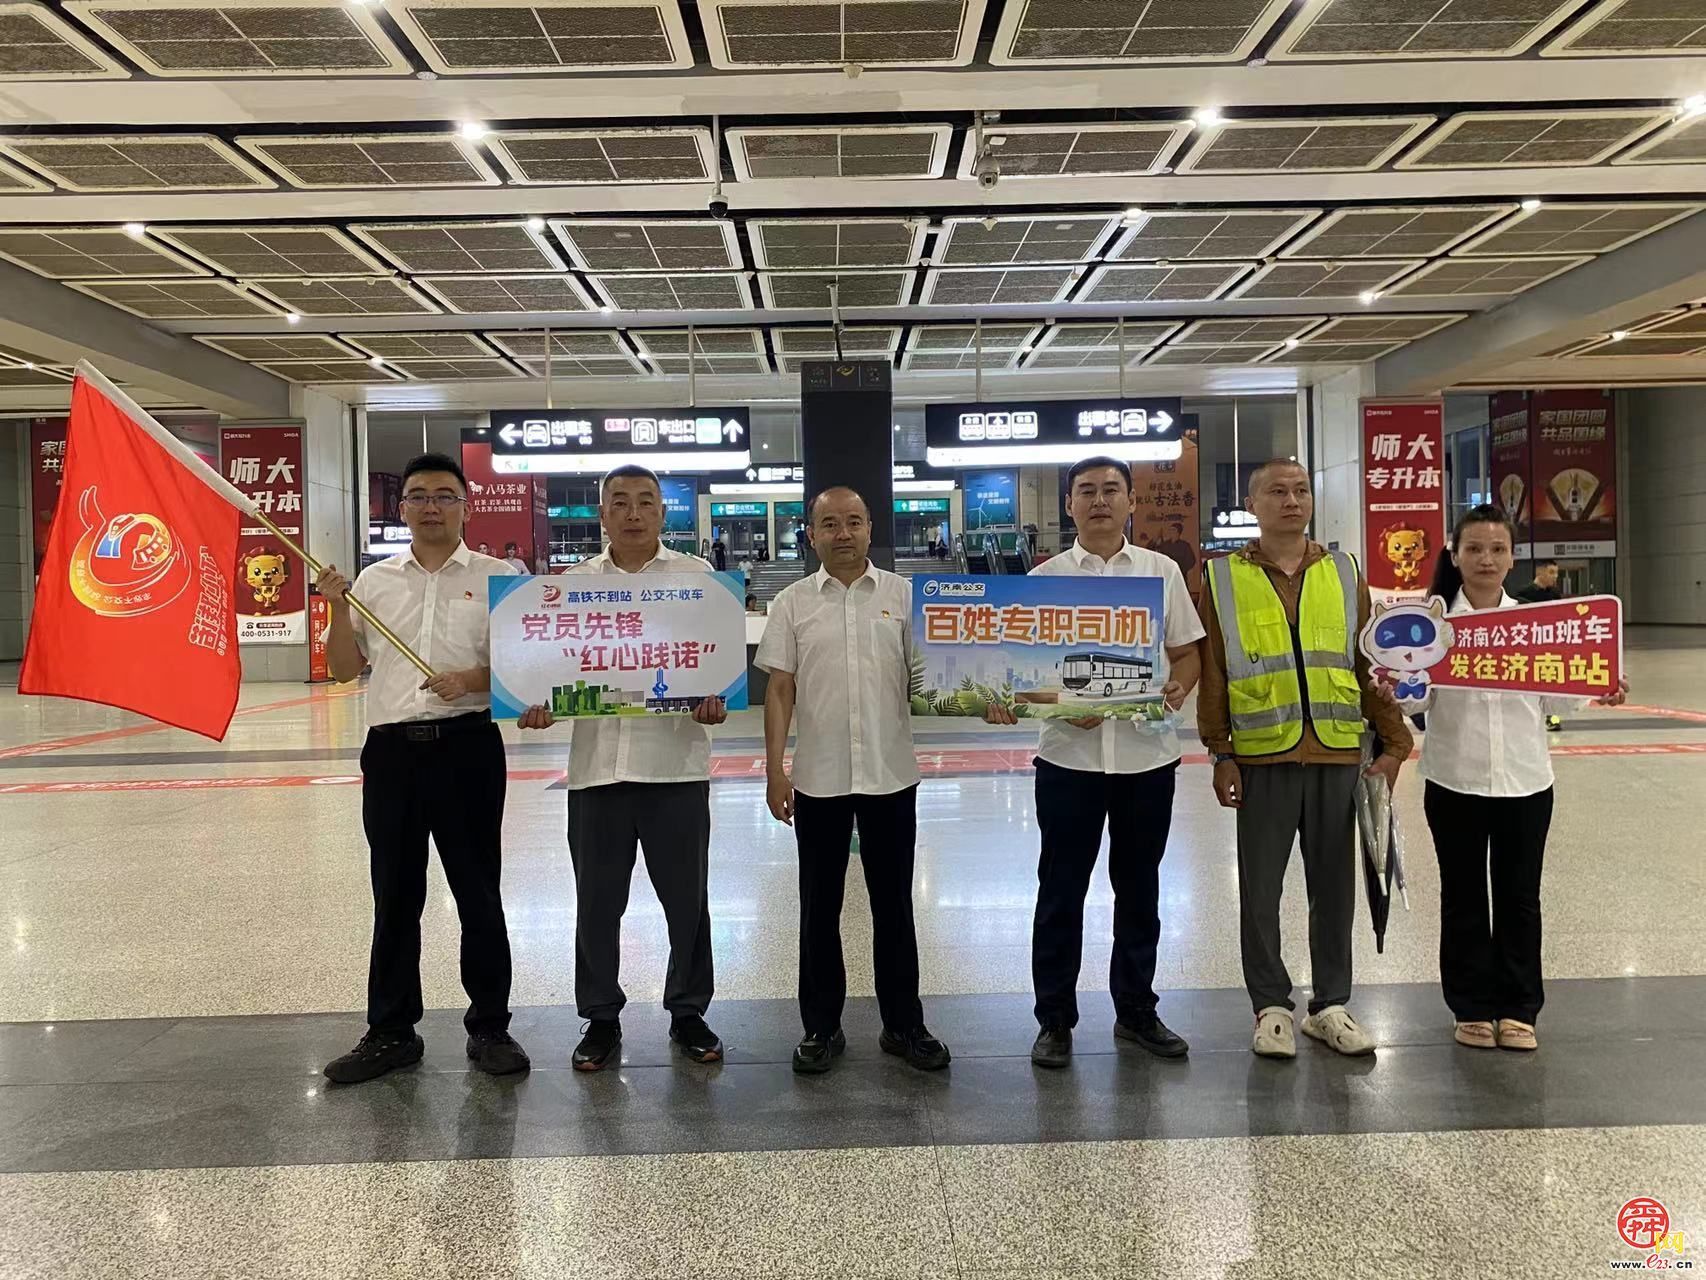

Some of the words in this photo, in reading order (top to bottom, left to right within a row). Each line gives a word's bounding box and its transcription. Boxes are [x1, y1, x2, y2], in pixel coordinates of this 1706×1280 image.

[1371, 433, 1436, 461] 师大
[229, 457, 296, 484] 师大
[1366, 466, 1441, 490] 专升本
[244, 490, 302, 513] 升本
[486, 483, 527, 495] 八马茶业
[567, 590, 632, 603] 高铁不到站
[640, 588, 704, 602] 公交不收车
[521, 611, 644, 642] 党员先锋
[924, 605, 1151, 644] 百姓专职司机
[1457, 615, 1613, 648] 济南公交加班车
[1450, 652, 1611, 688] 发往济南站
